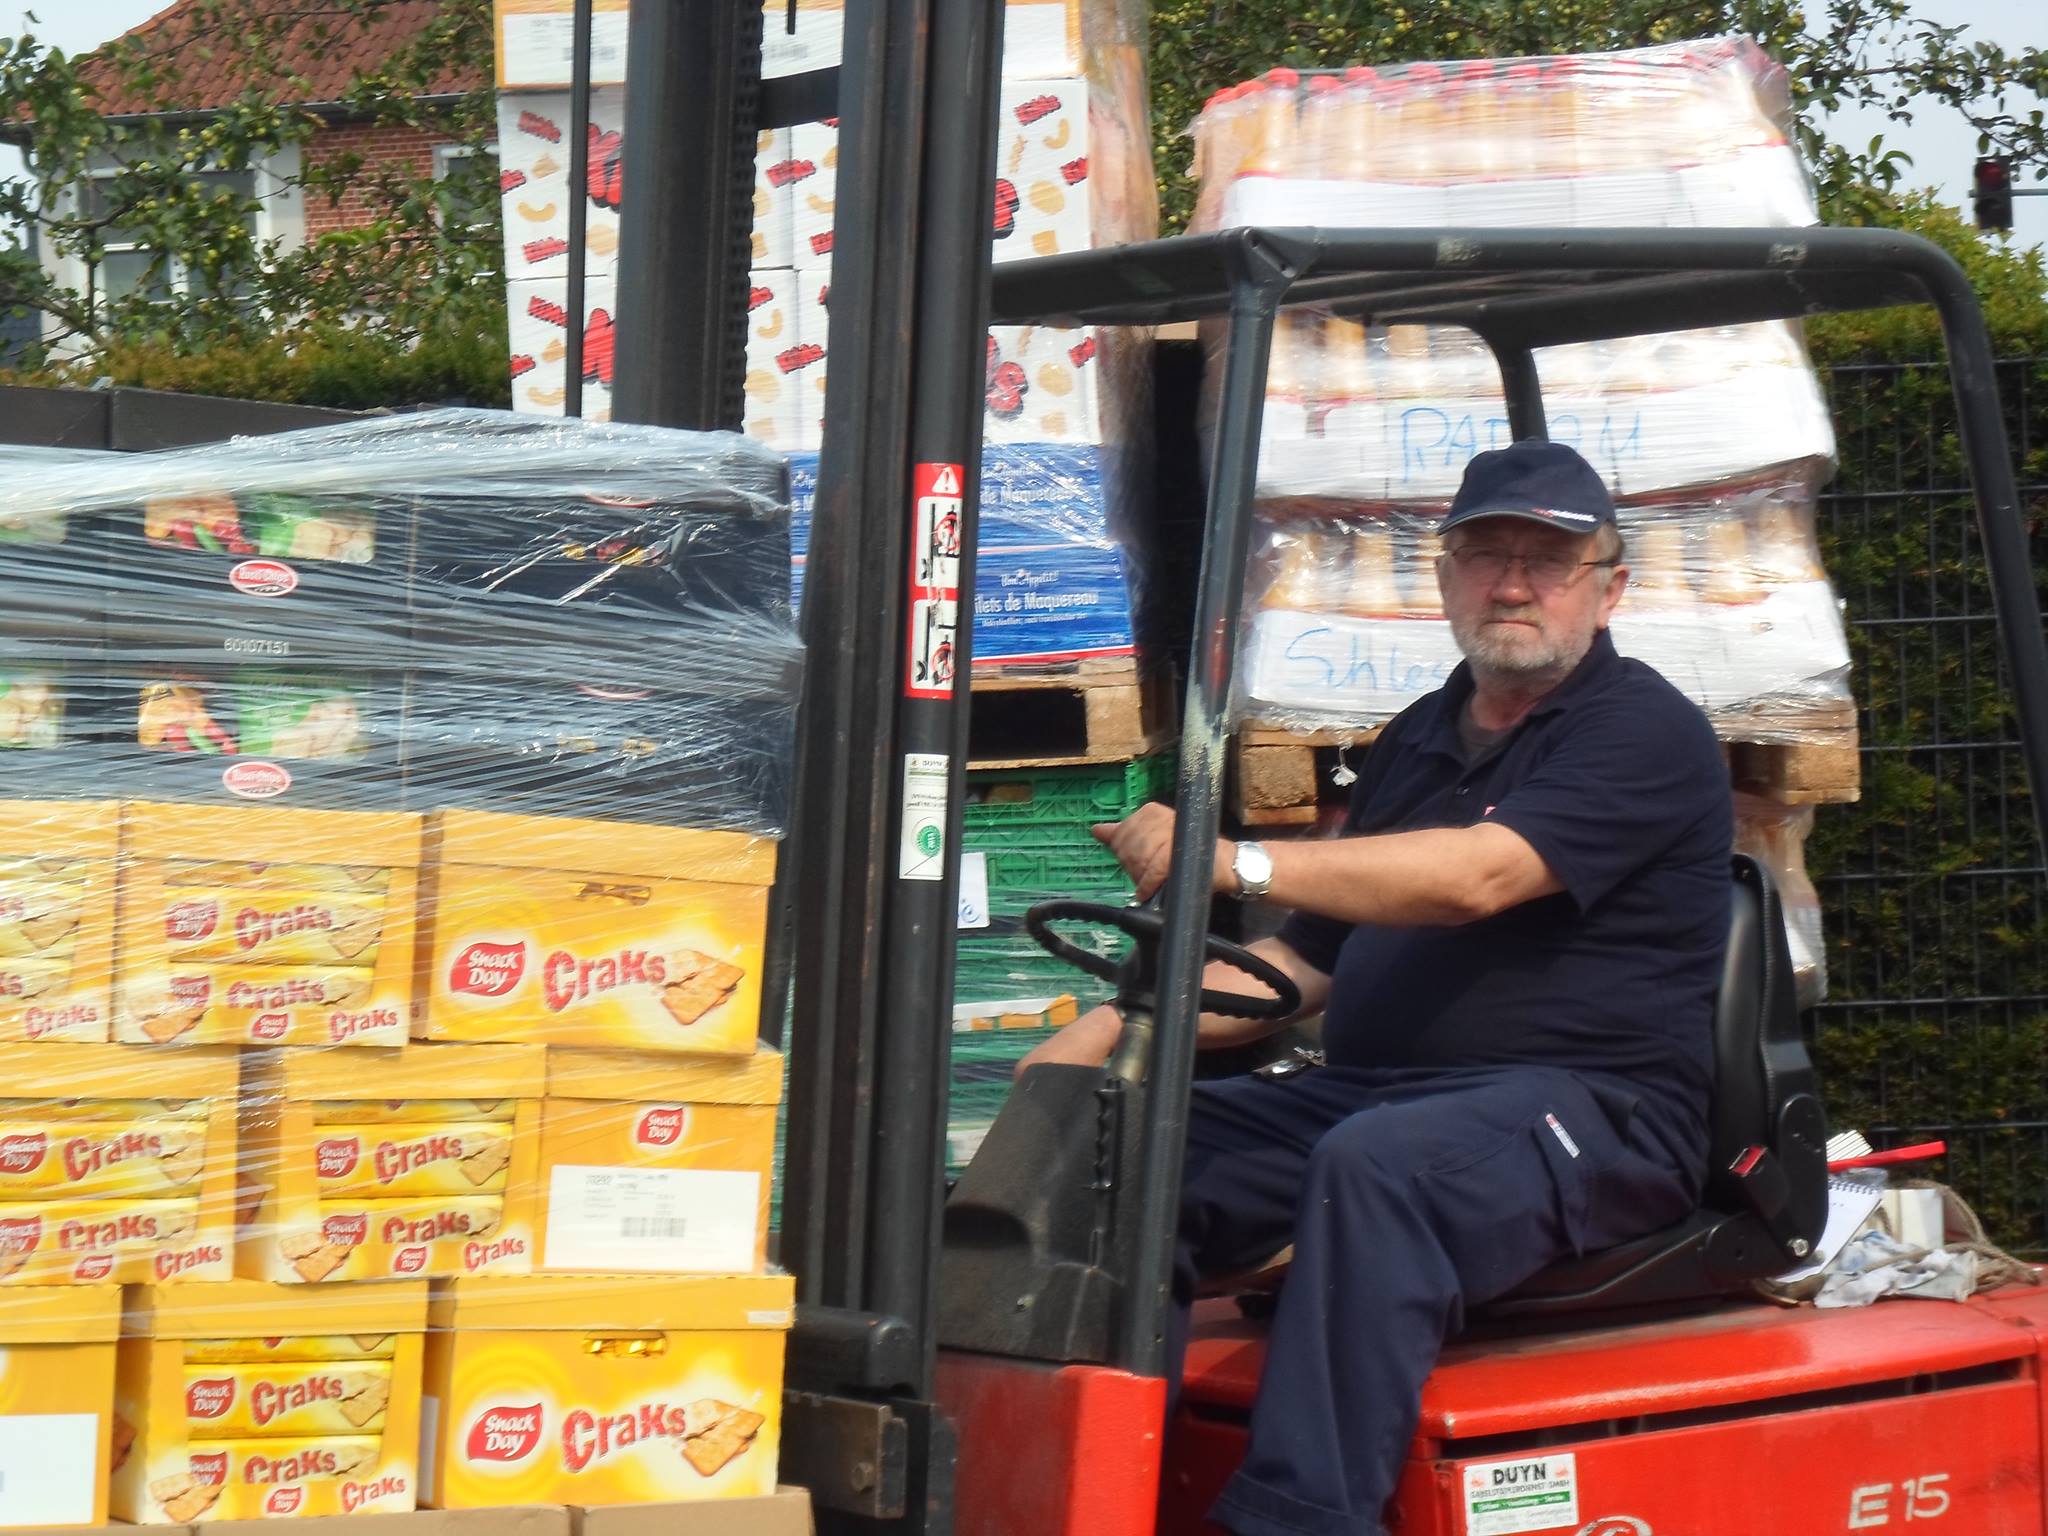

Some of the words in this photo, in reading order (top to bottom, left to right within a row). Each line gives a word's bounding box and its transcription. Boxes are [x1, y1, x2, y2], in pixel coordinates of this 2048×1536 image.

[1004, 591, 1021, 611] de
[1024, 590, 1099, 612] Maquereau
[467, 950, 519, 970] Snack
[468, 968, 509, 993] Day
[192, 1384, 231, 1399] Snack
[194, 1397, 225, 1416] Day
[485, 1414, 536, 1434] Snack
[486, 1432, 527, 1458] Day
[1493, 1463, 1546, 1486] DUYN
[1848, 1482, 1893, 1530] E
[1902, 1473, 1950, 1522] 15
